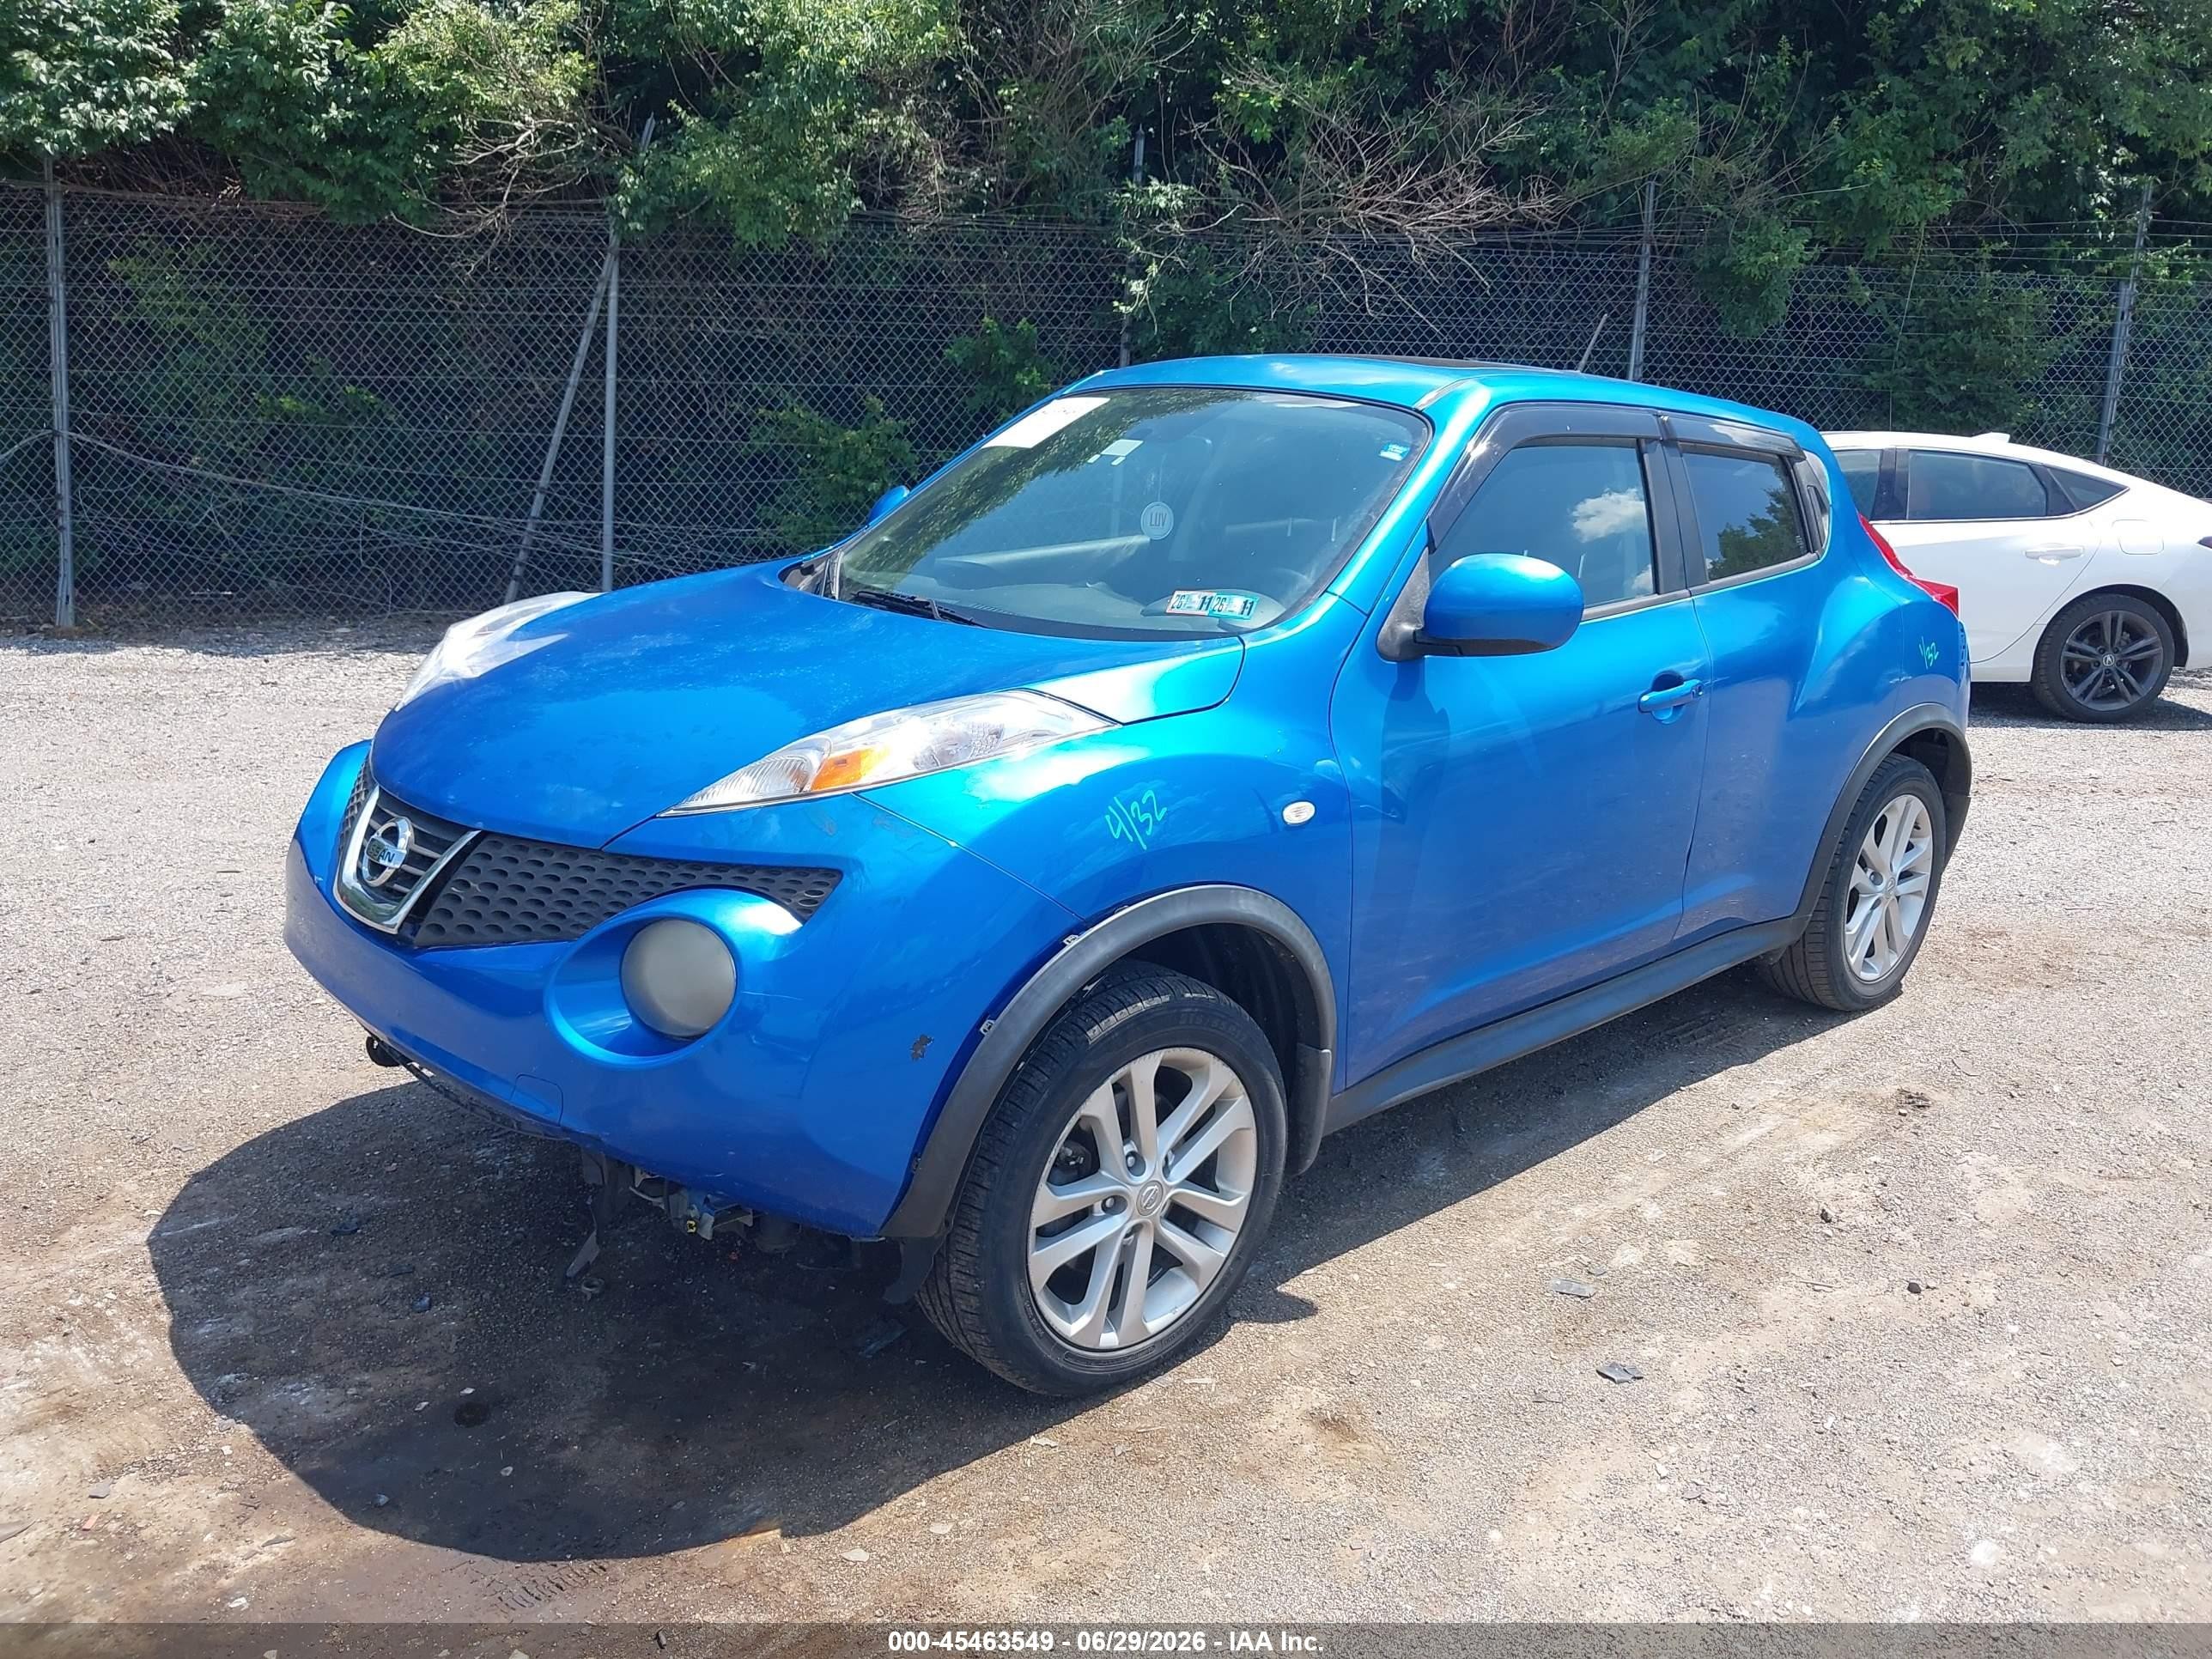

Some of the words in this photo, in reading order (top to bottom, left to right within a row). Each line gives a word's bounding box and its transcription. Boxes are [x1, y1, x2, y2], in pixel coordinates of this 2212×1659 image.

[1171, 594, 1186, 610] 26
[1199, 595, 1214, 611] 11
[1212, 597, 1227, 612] 26
